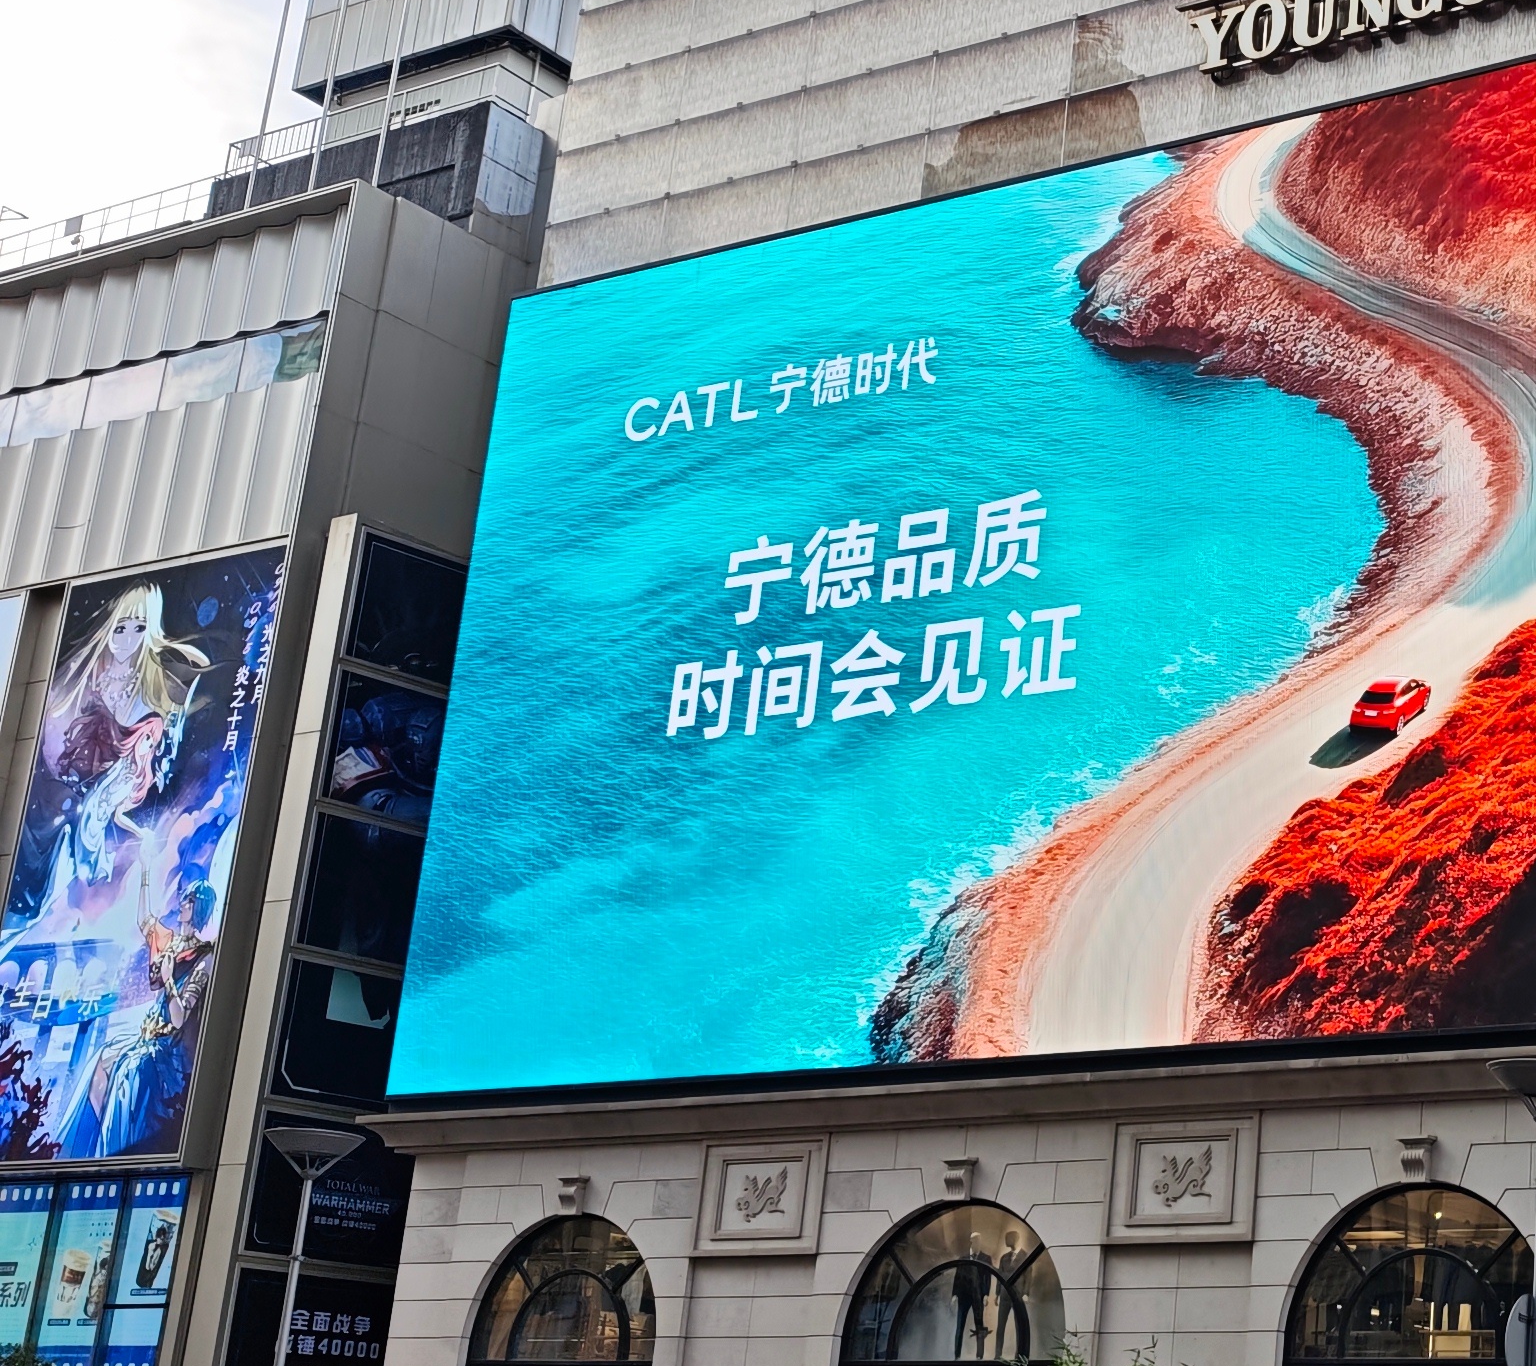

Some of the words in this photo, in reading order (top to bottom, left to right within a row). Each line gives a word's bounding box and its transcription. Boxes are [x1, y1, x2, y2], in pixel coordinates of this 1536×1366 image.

[624, 379, 758, 442] CATL
[769, 336, 939, 414] 宁德时代
[724, 488, 1048, 626] 宁德品质
[666, 603, 1082, 740] 时间会见证
[311, 1193, 390, 1216] WARHAMMER
[290, 1309, 371, 1336] 全面战争
